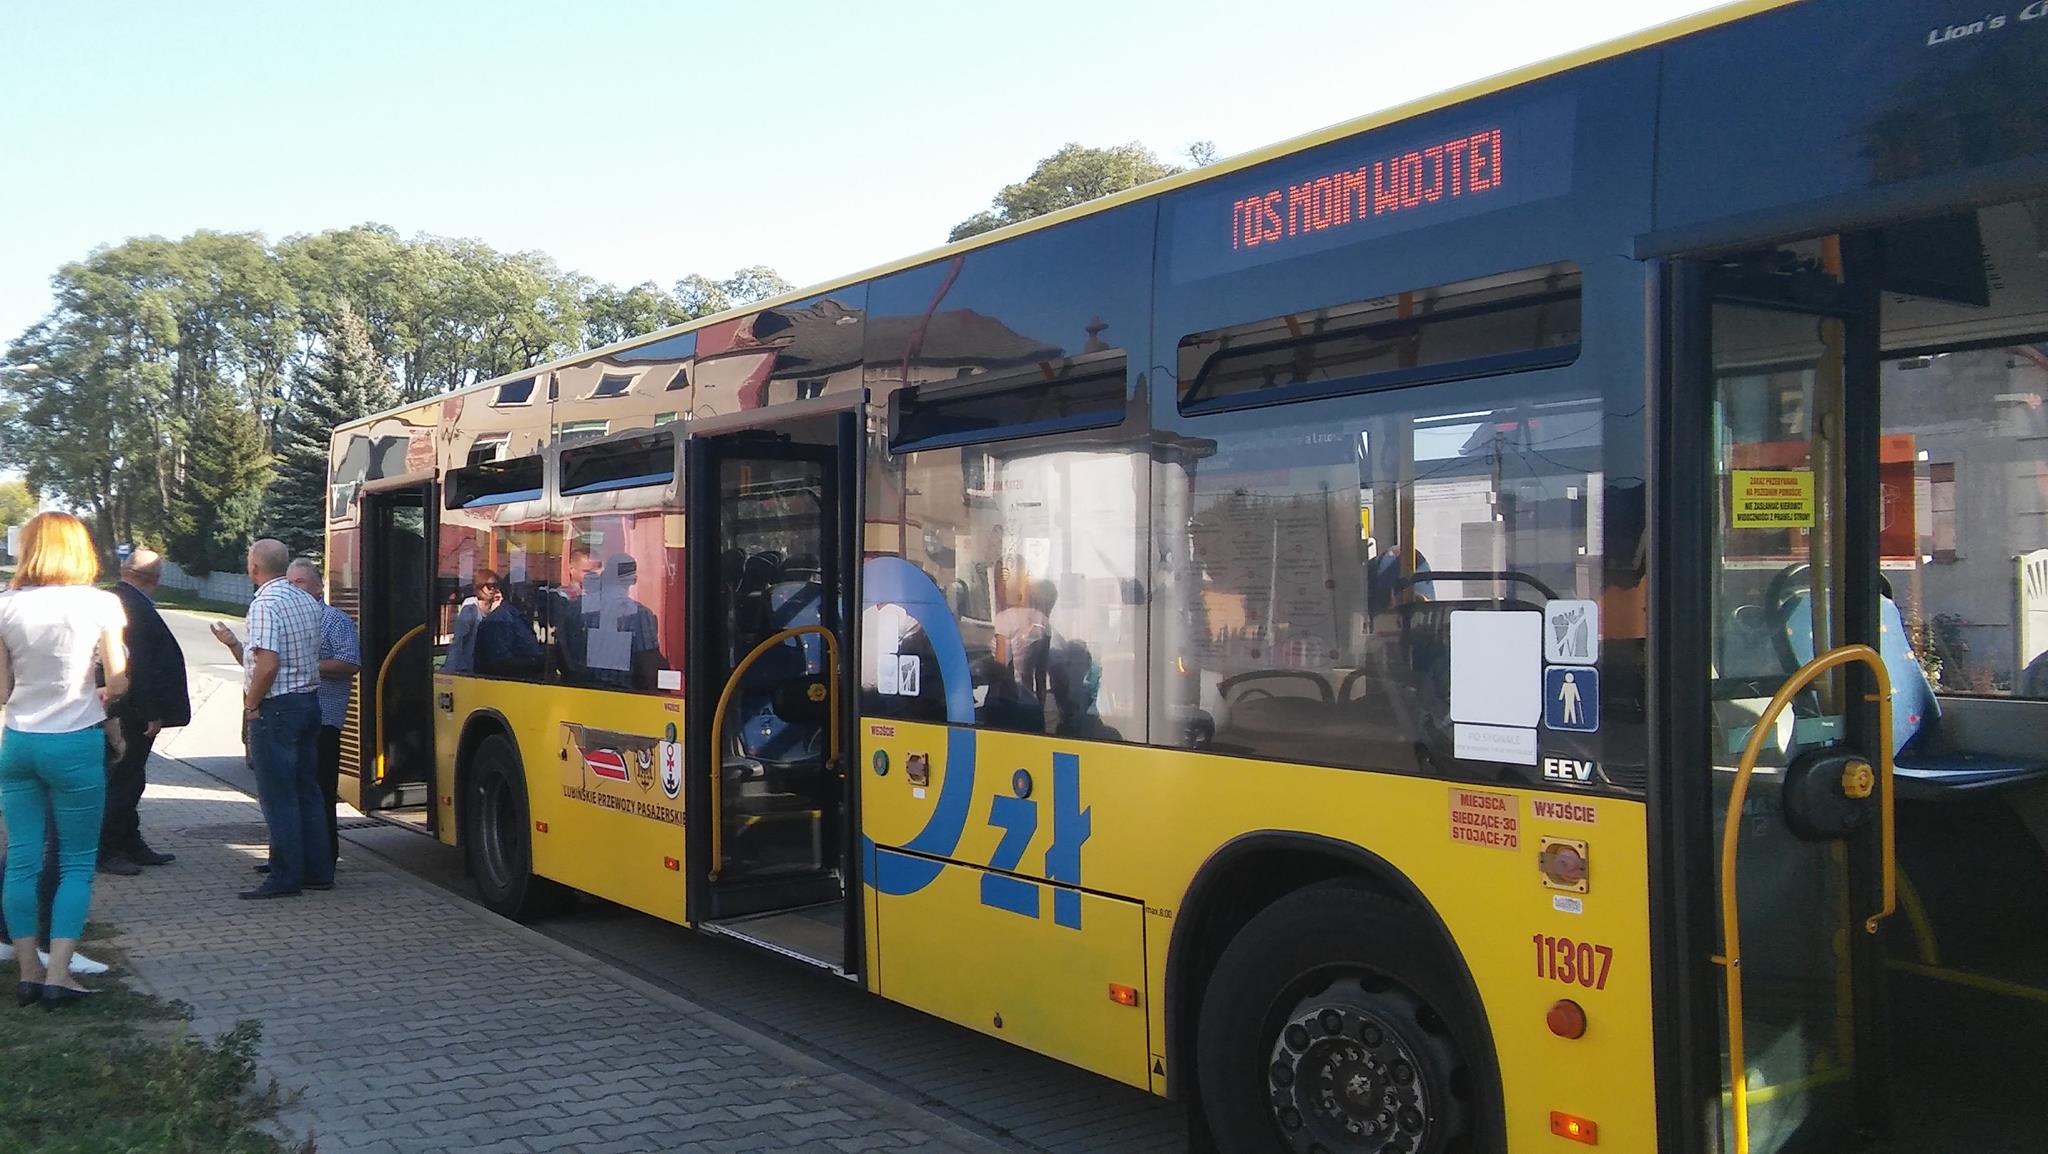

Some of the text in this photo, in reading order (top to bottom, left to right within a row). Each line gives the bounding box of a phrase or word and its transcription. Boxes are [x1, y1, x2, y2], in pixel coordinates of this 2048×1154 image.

[1927, 13, 2006, 46] Lion's
[1288, 166, 1367, 236] MOIM
[1544, 757, 1594, 781] EEV
[563, 784, 686, 826] LUBIŃSKIE PRZEWOZY PASAŻERSKIE
[1460, 793, 1506, 811] MIEJSCA
[1534, 801, 1595, 823] WYJŚCIE
[1452, 810, 1517, 831] SIEDZĄCE-30
[1452, 826, 1517, 848] STOJĄCE-70
[1533, 933, 1613, 990] 11307
